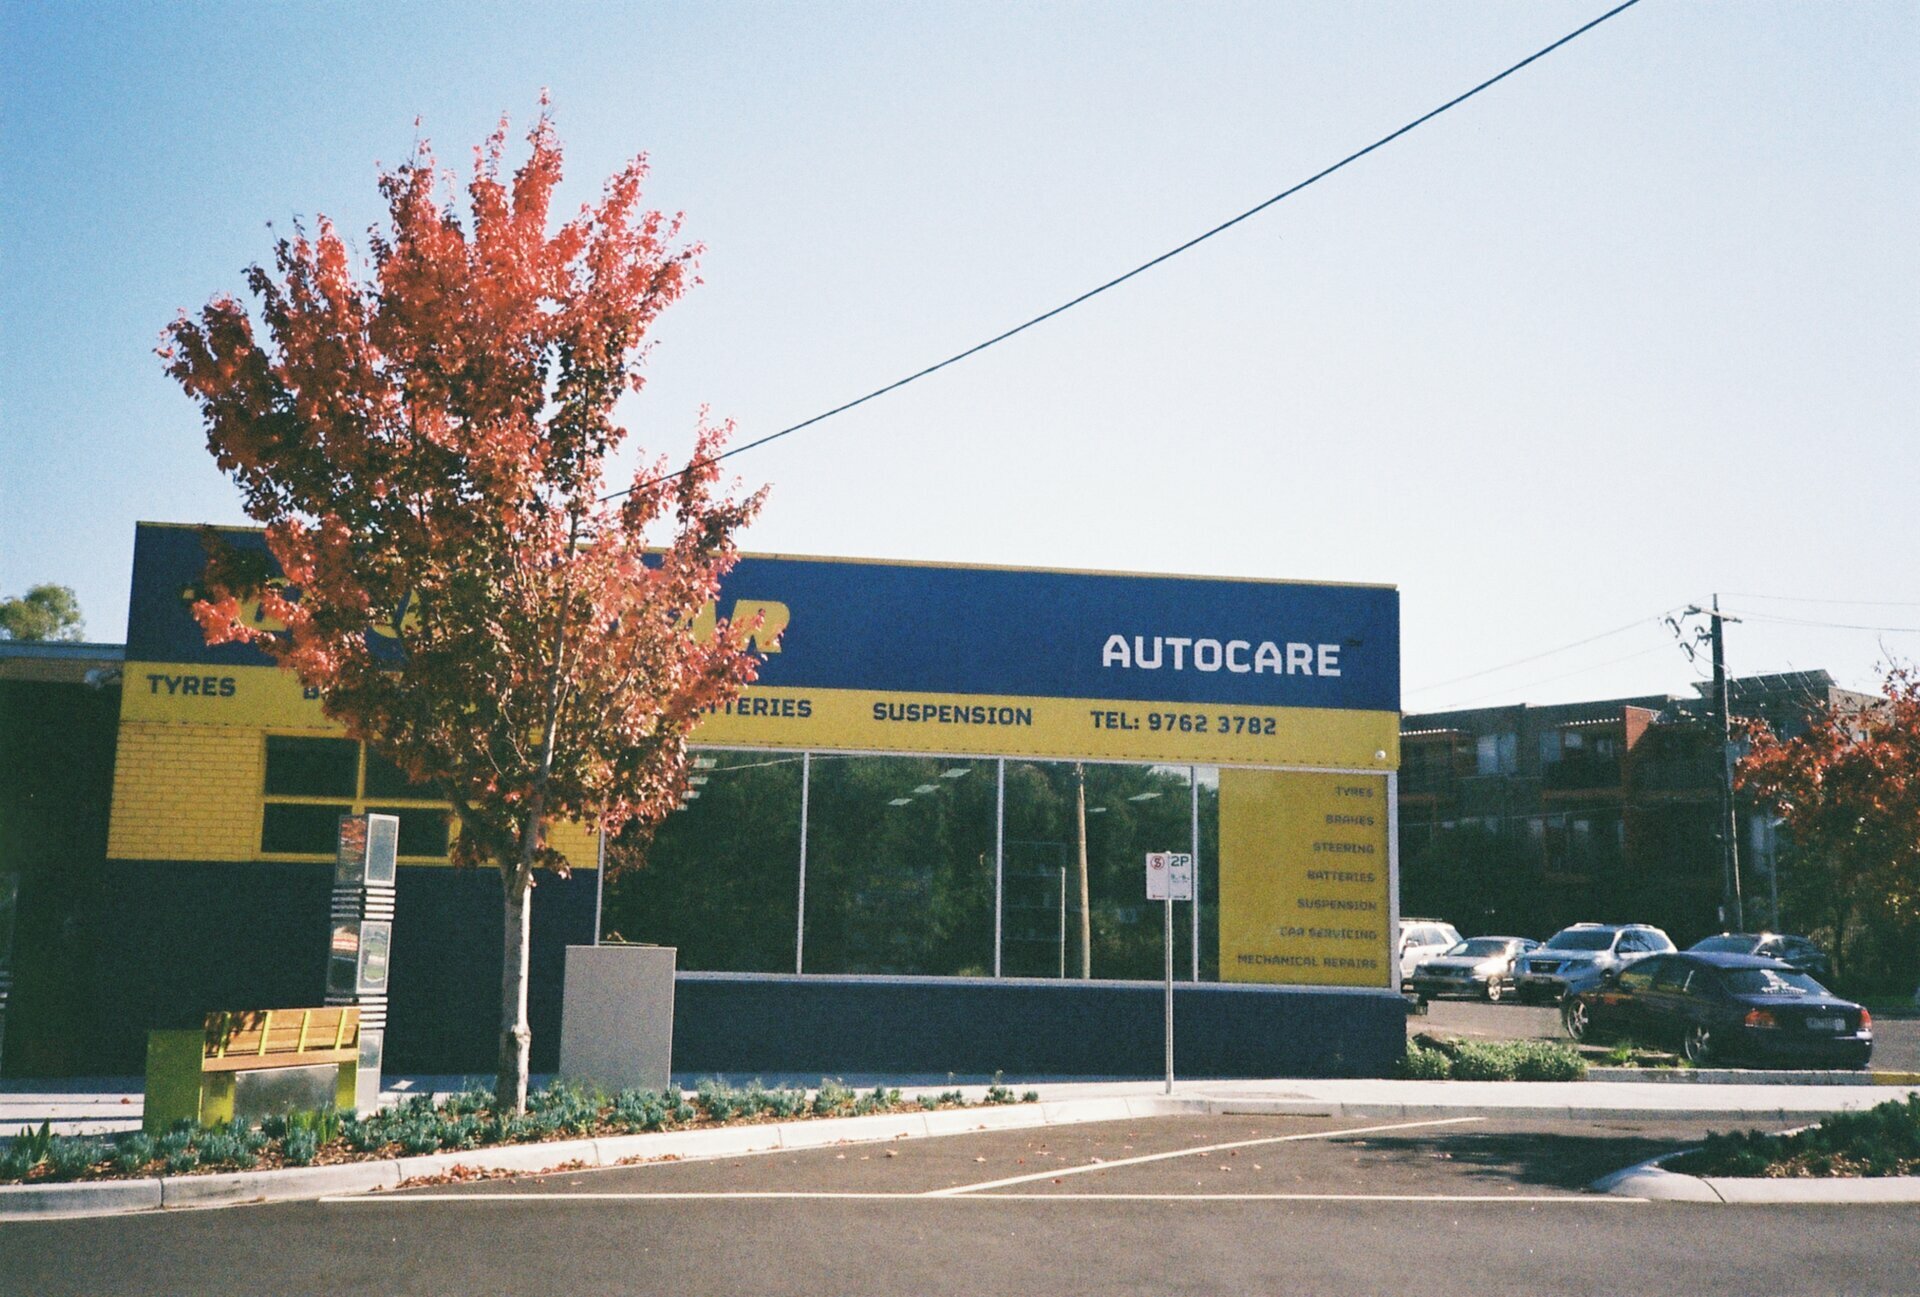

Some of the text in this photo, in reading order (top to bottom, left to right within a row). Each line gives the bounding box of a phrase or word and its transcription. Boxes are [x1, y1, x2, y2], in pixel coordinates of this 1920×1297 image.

[1102, 634, 1342, 677] AUTOCARE
[146, 674, 236, 697] TYRES
[873, 702, 1032, 726] SUSPENSION
[1090, 710, 1276, 736] TEL: 9762 3782
[1335, 786, 1374, 798] TYRES
[1325, 814, 1375, 827] BRAKES
[1312, 842, 1375, 854] STEERING
[1170, 855, 1189, 867] 2P
[1306, 869, 1375, 883] BATTERIES
[1296, 898, 1377, 911] SUSPENSION
[1278, 926, 1377, 940] CAR SERVICING
[1237, 954, 1377, 970] MECHANICAL REPAIRS
